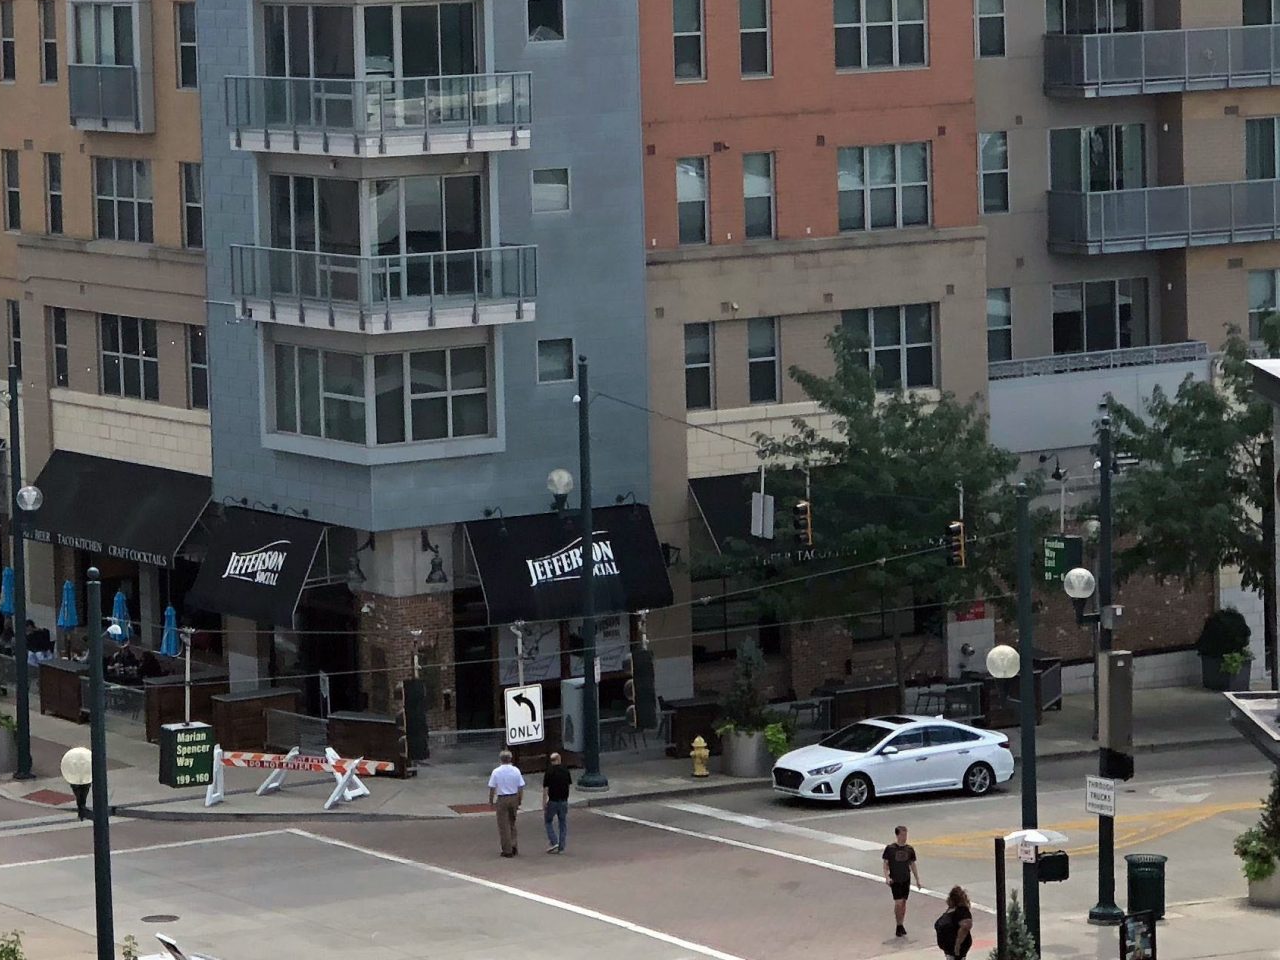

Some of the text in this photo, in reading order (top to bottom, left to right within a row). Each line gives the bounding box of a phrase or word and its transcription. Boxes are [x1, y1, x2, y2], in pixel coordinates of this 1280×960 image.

[57, 534, 74, 547] TACO
[75, 538, 102, 553] KITCHEN
[109, 545, 128, 559] CRAFT
[129, 550, 167, 566] COCKTAILS
[222, 551, 287, 578] JEFFERSON
[255, 571, 278, 586] SOCIAL
[510, 724, 540, 739] ONLY
[177, 732, 206, 743] Marian
[176, 745, 210, 756] Spencer
[176, 757, 194, 768] Way
[263, 761, 279, 769] NOT
[282, 762, 313, 771] ENTER
[1090, 792, 1111, 802] TRUCKS
